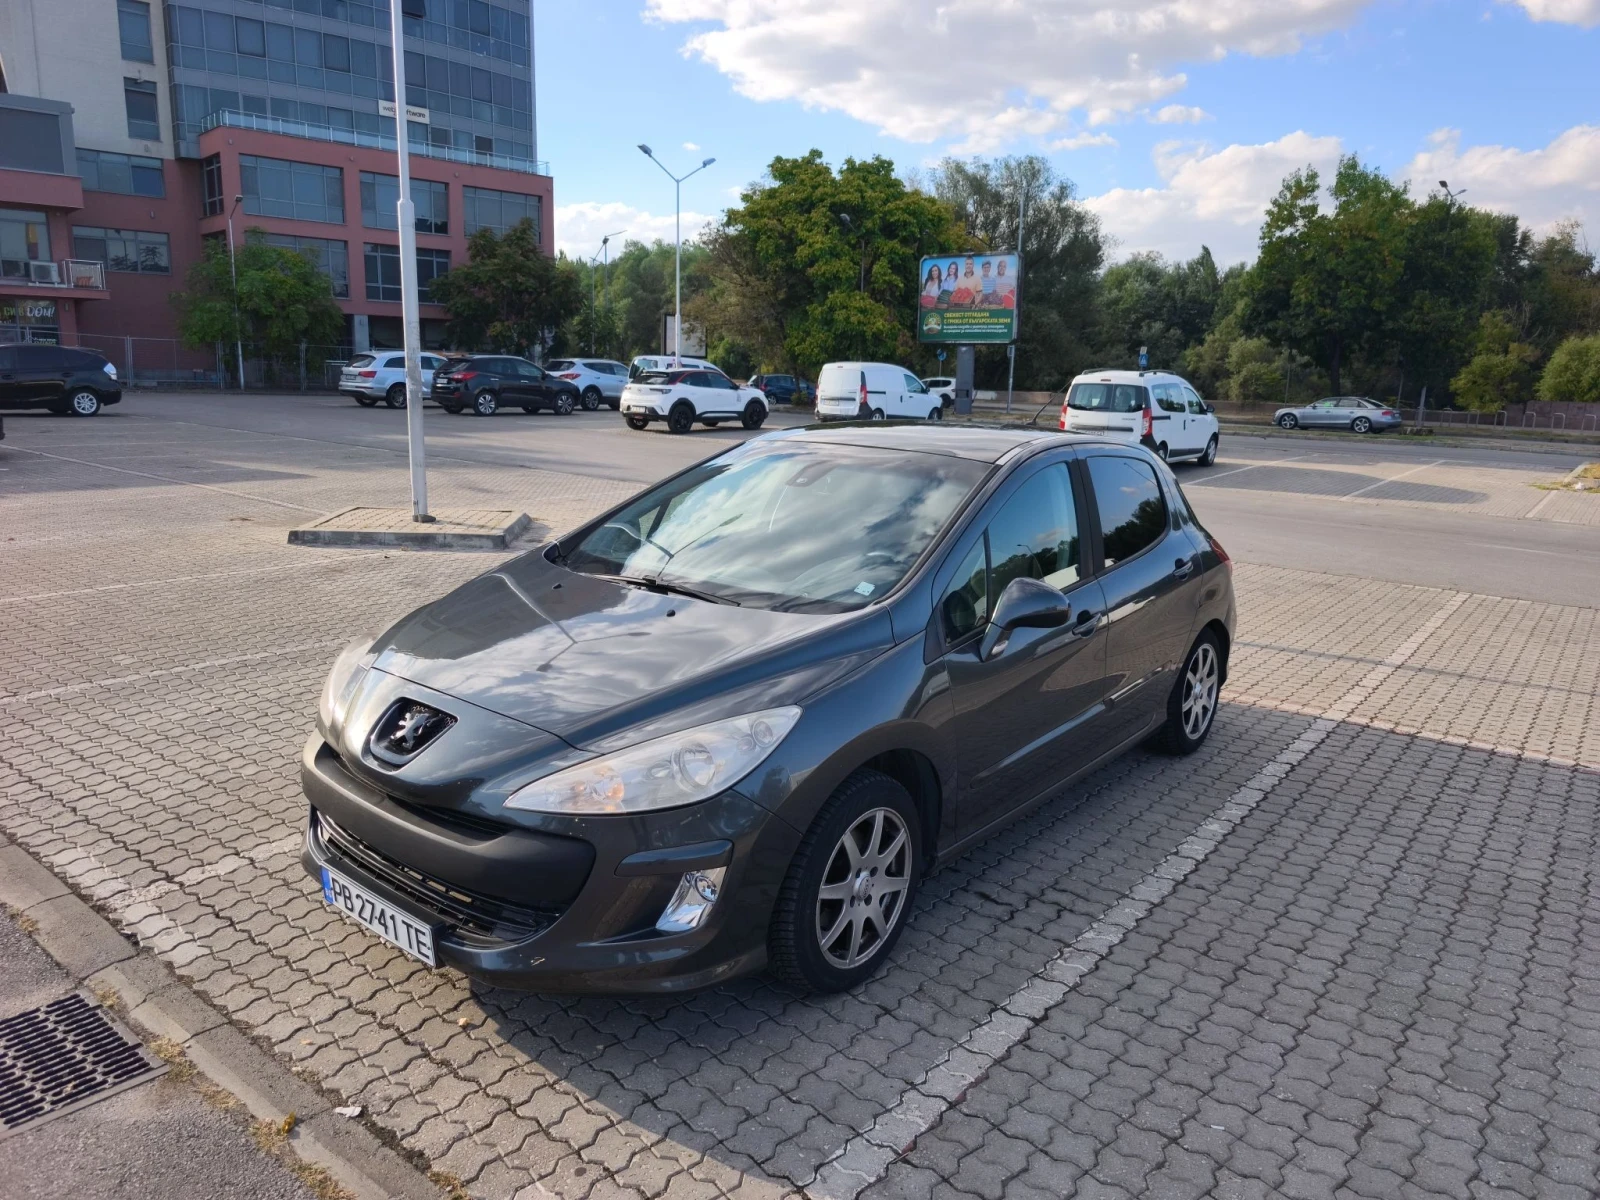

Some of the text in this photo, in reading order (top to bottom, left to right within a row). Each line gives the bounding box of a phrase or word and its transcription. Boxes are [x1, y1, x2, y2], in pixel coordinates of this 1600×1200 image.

[331, 876, 430, 960] PB 2741 TE
